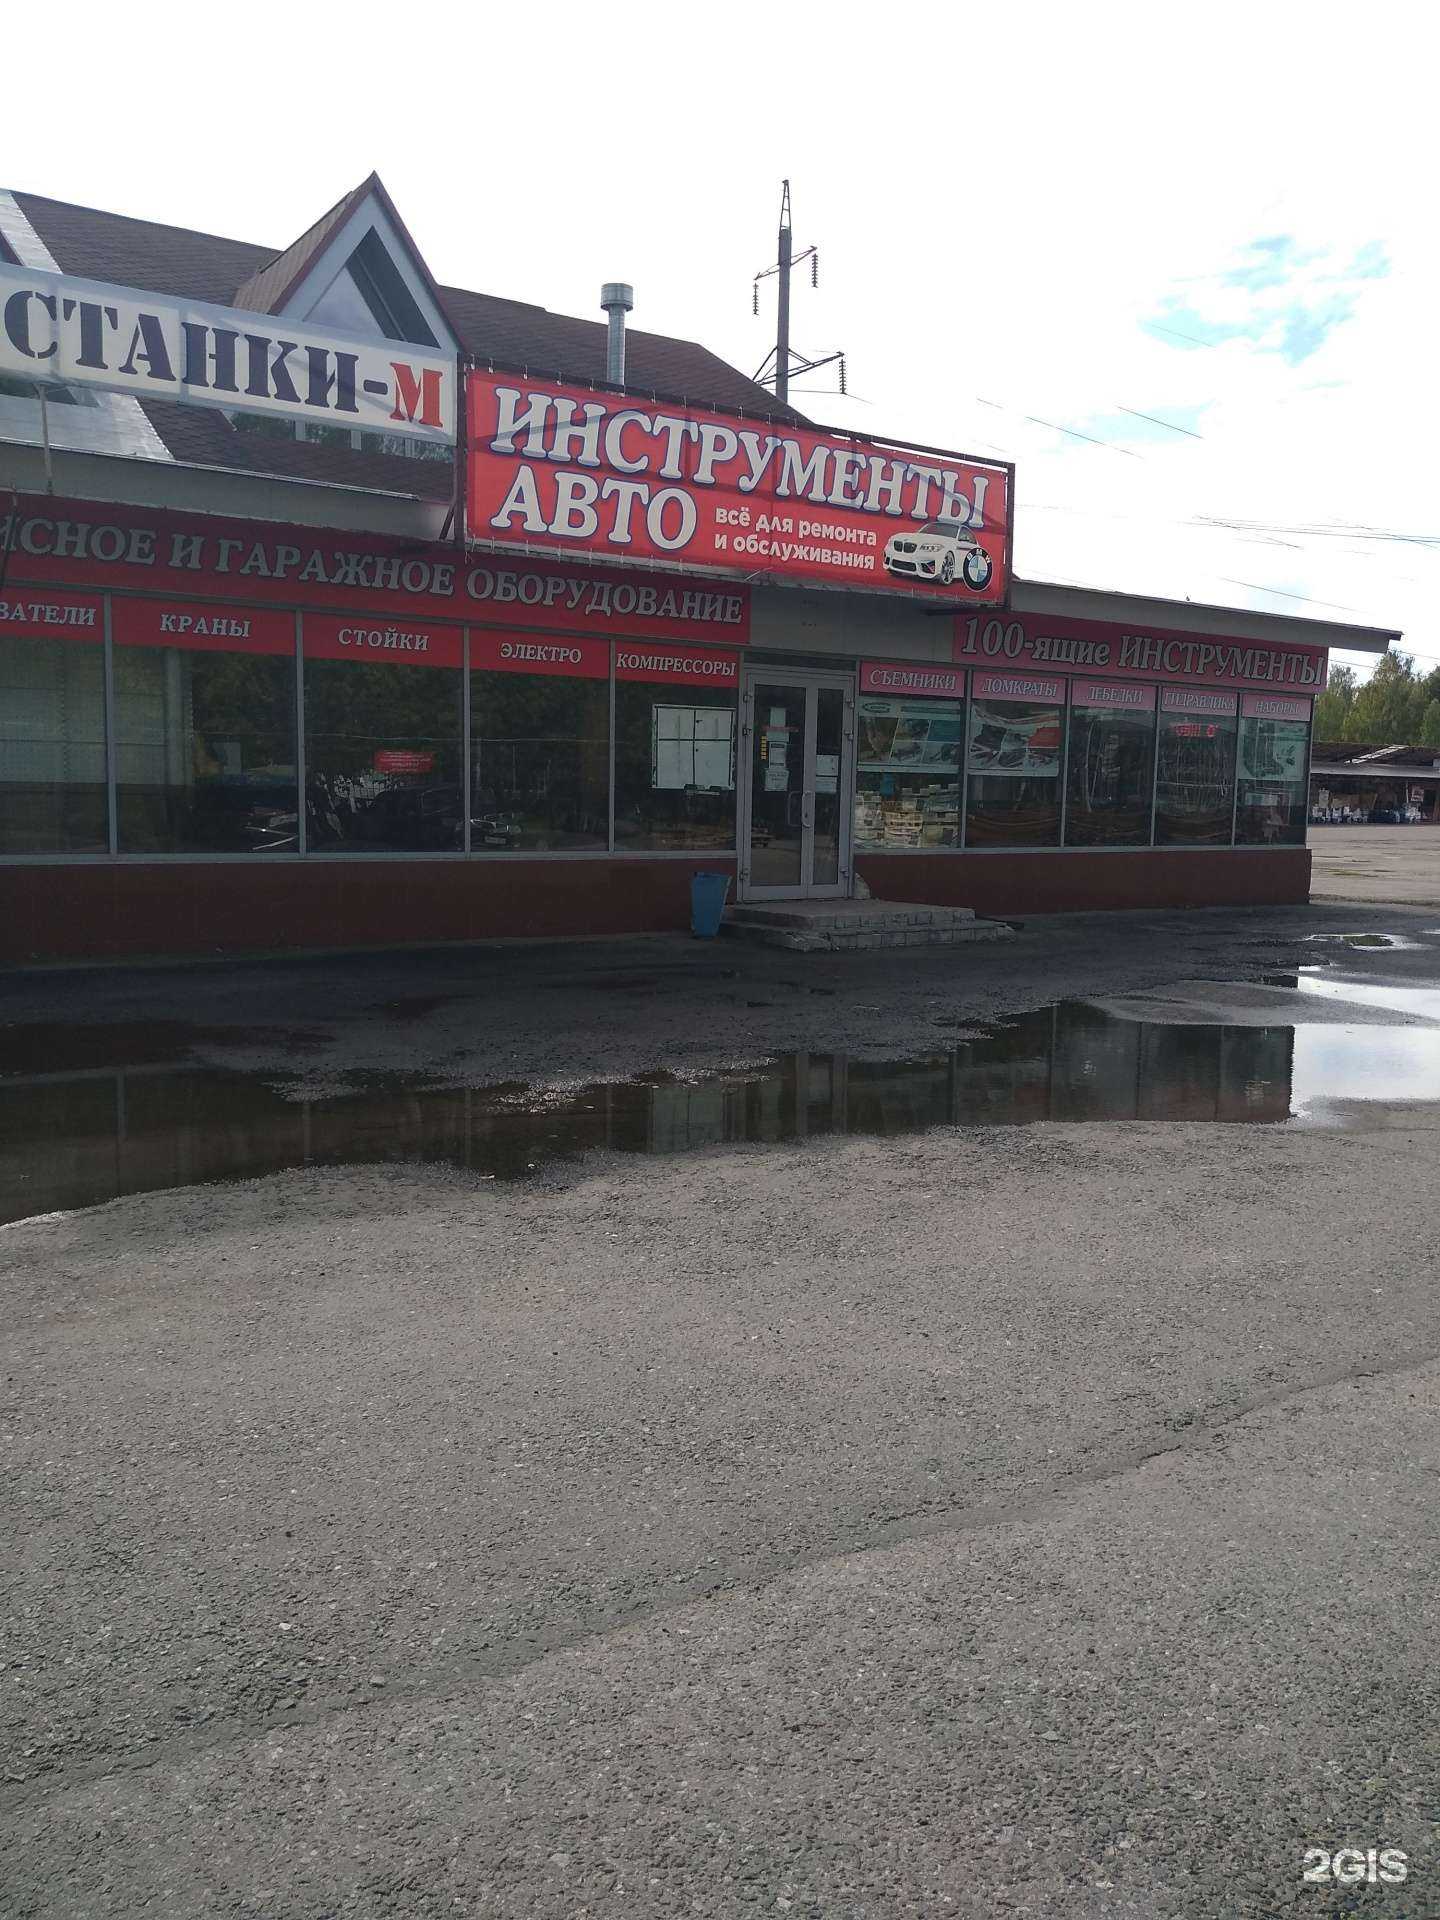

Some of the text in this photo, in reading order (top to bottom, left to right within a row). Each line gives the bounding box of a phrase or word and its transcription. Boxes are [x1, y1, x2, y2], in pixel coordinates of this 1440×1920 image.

[4, 290, 444, 428] СТАНКИ-М
[490, 387, 989, 528] ИНСТРУМЕНТЫ
[490, 464, 699, 551] АВТО
[715, 507, 877, 546] всё для ремонта
[714, 534, 875, 570] и обслуживания
[168, 533, 205, 569] И
[215, 538, 456, 597] ГАРАЖНОЕ
[466, 568, 743, 625] ОБОРУДОВАНИЕ
[160, 613, 250, 637] КРАНЫ
[338, 628, 430, 652] СТОЙКИ
[500, 642, 583, 664] ЭЛЕКТРО
[616, 653, 737, 677] КОМПРЕССОРЫ
[961, 617, 1326, 686] 100-ящие ИНСТРУМЕНТЫ
[870, 669, 956, 691] СЪЕМНИКИ
[982, 678, 1058, 698] ДОМКРАТЫ
